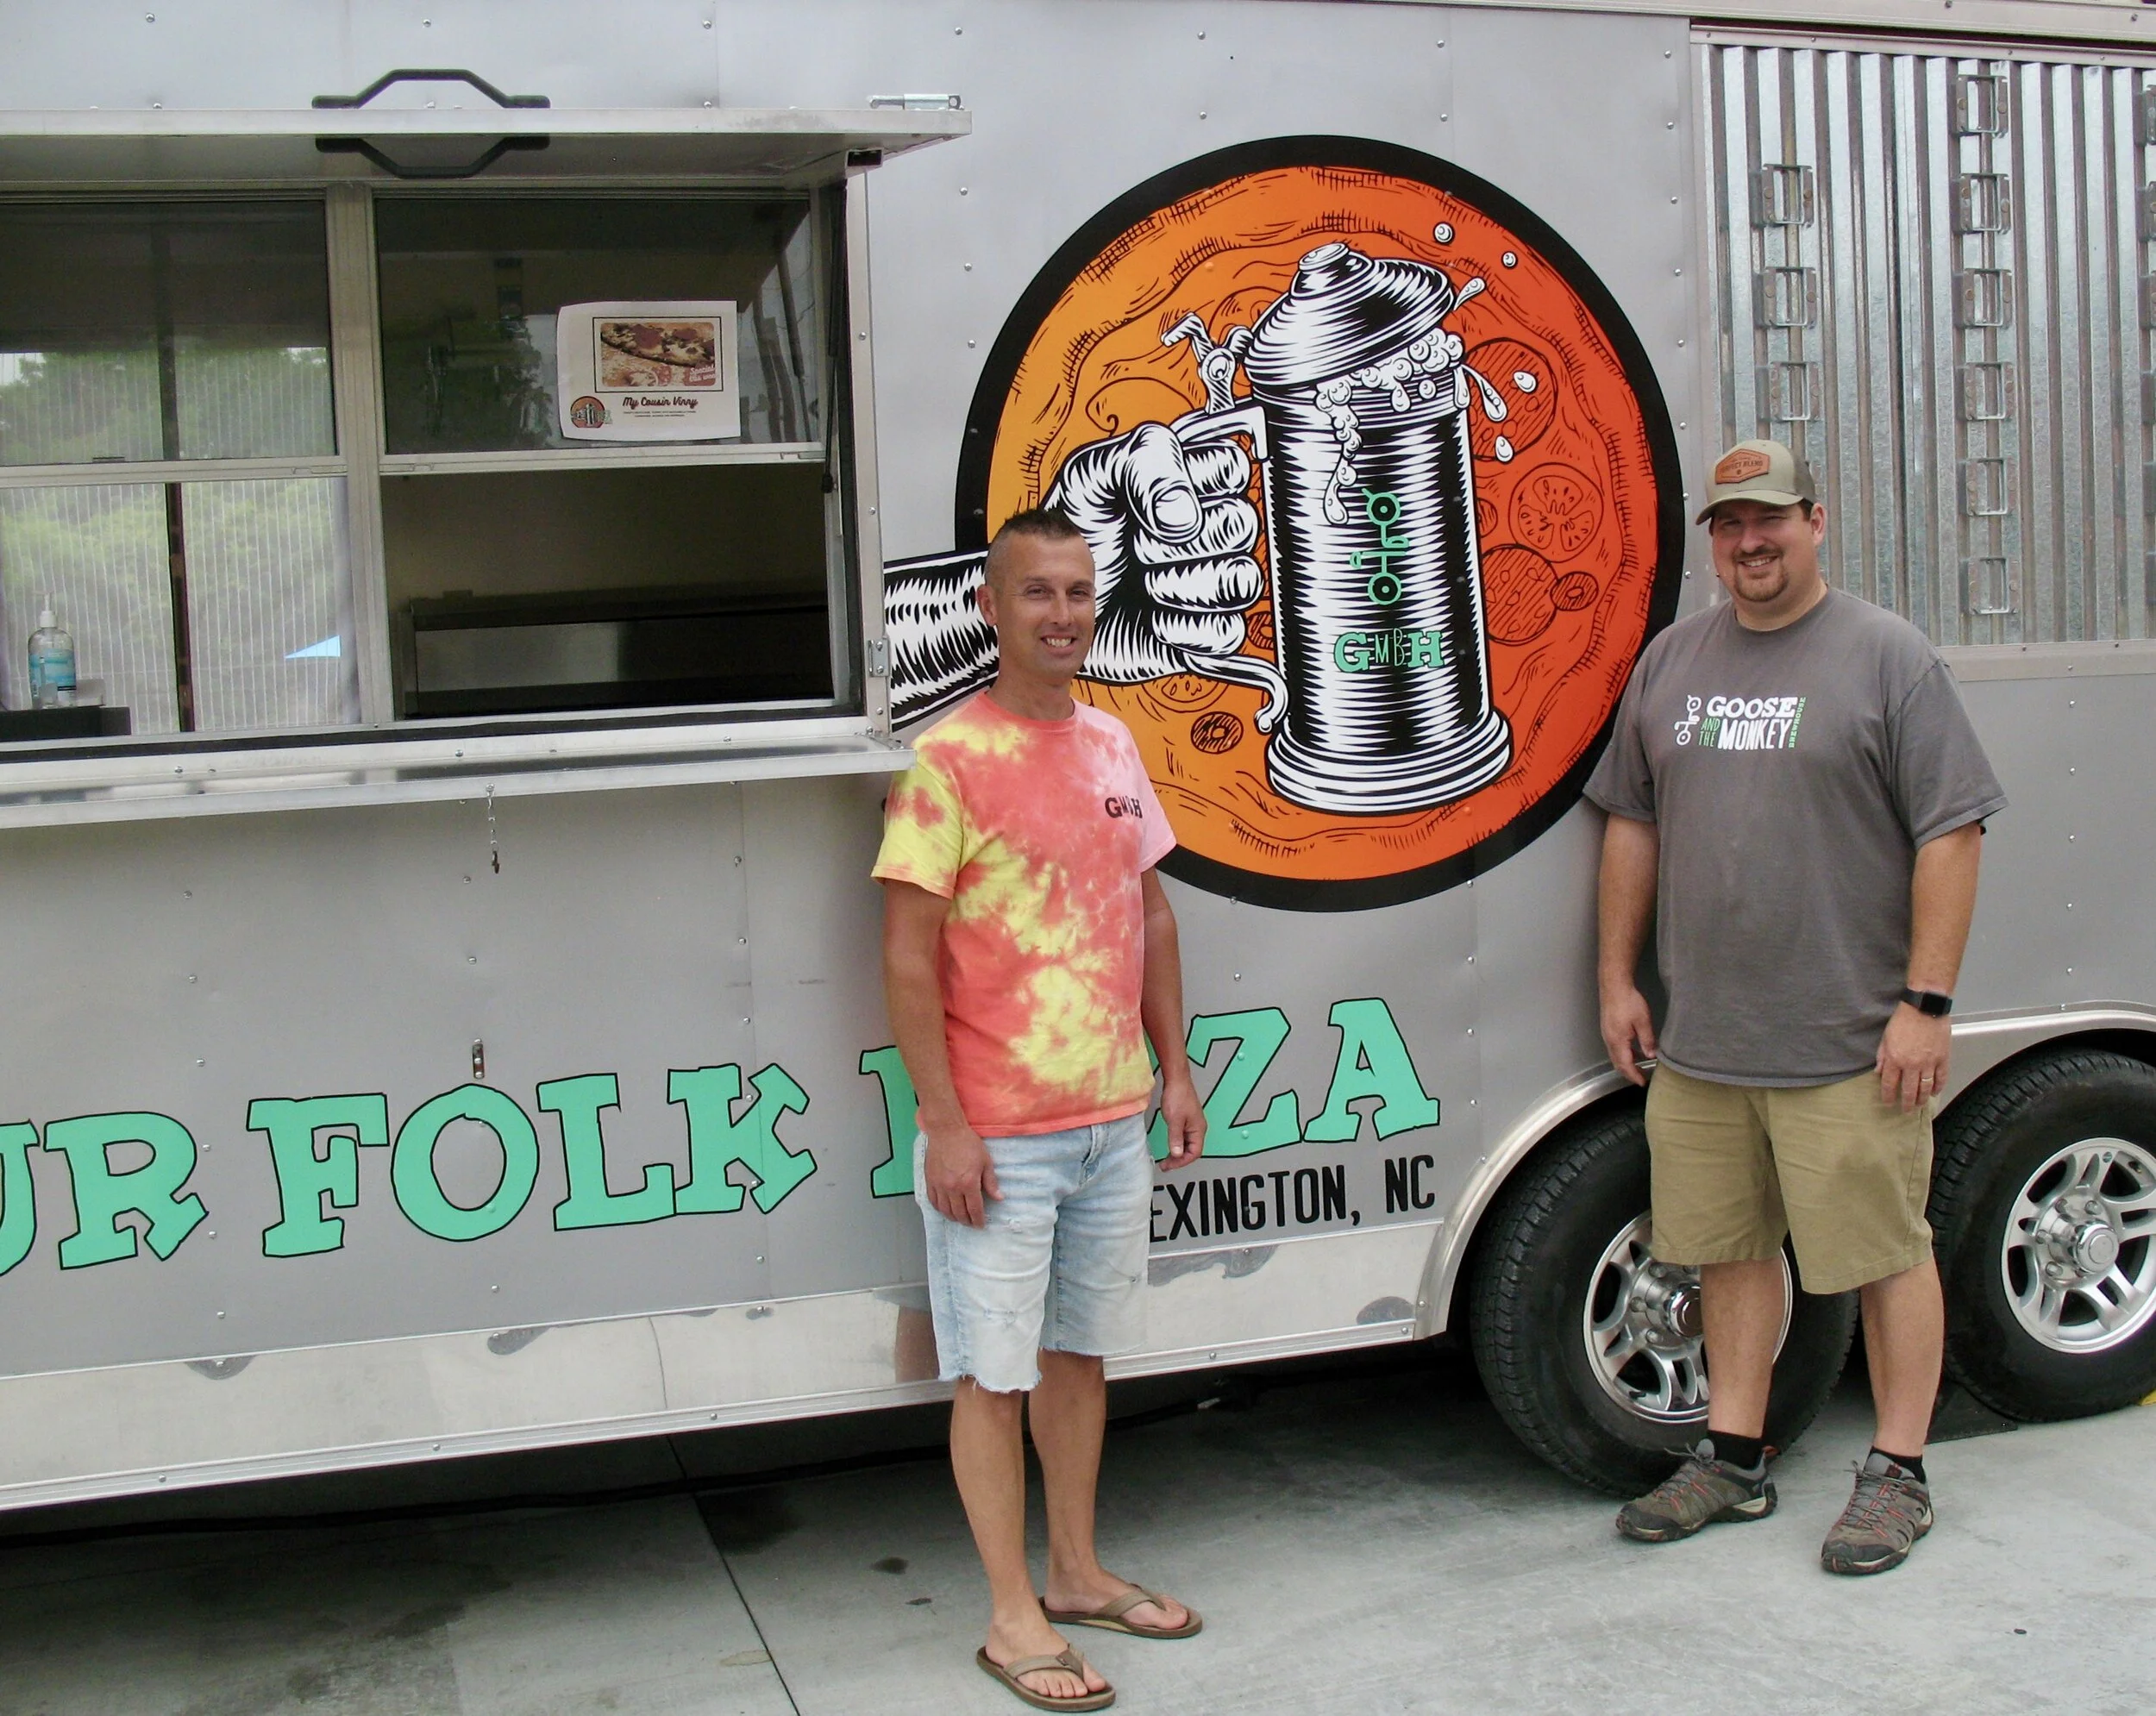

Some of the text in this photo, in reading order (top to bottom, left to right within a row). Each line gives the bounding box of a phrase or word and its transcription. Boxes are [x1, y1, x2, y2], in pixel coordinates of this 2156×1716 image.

[623, 396, 699, 410] My Cousin Vinny
[1706, 695, 1798, 719] GOOSE
[1701, 717, 1720, 731] AND
[1717, 718, 1793, 750] MONKEY
[1698, 730, 1716, 748] THE
[246, 1062, 818, 1258] FOLK
[1149, 1155, 1436, 1243] EXINGTON, NC
